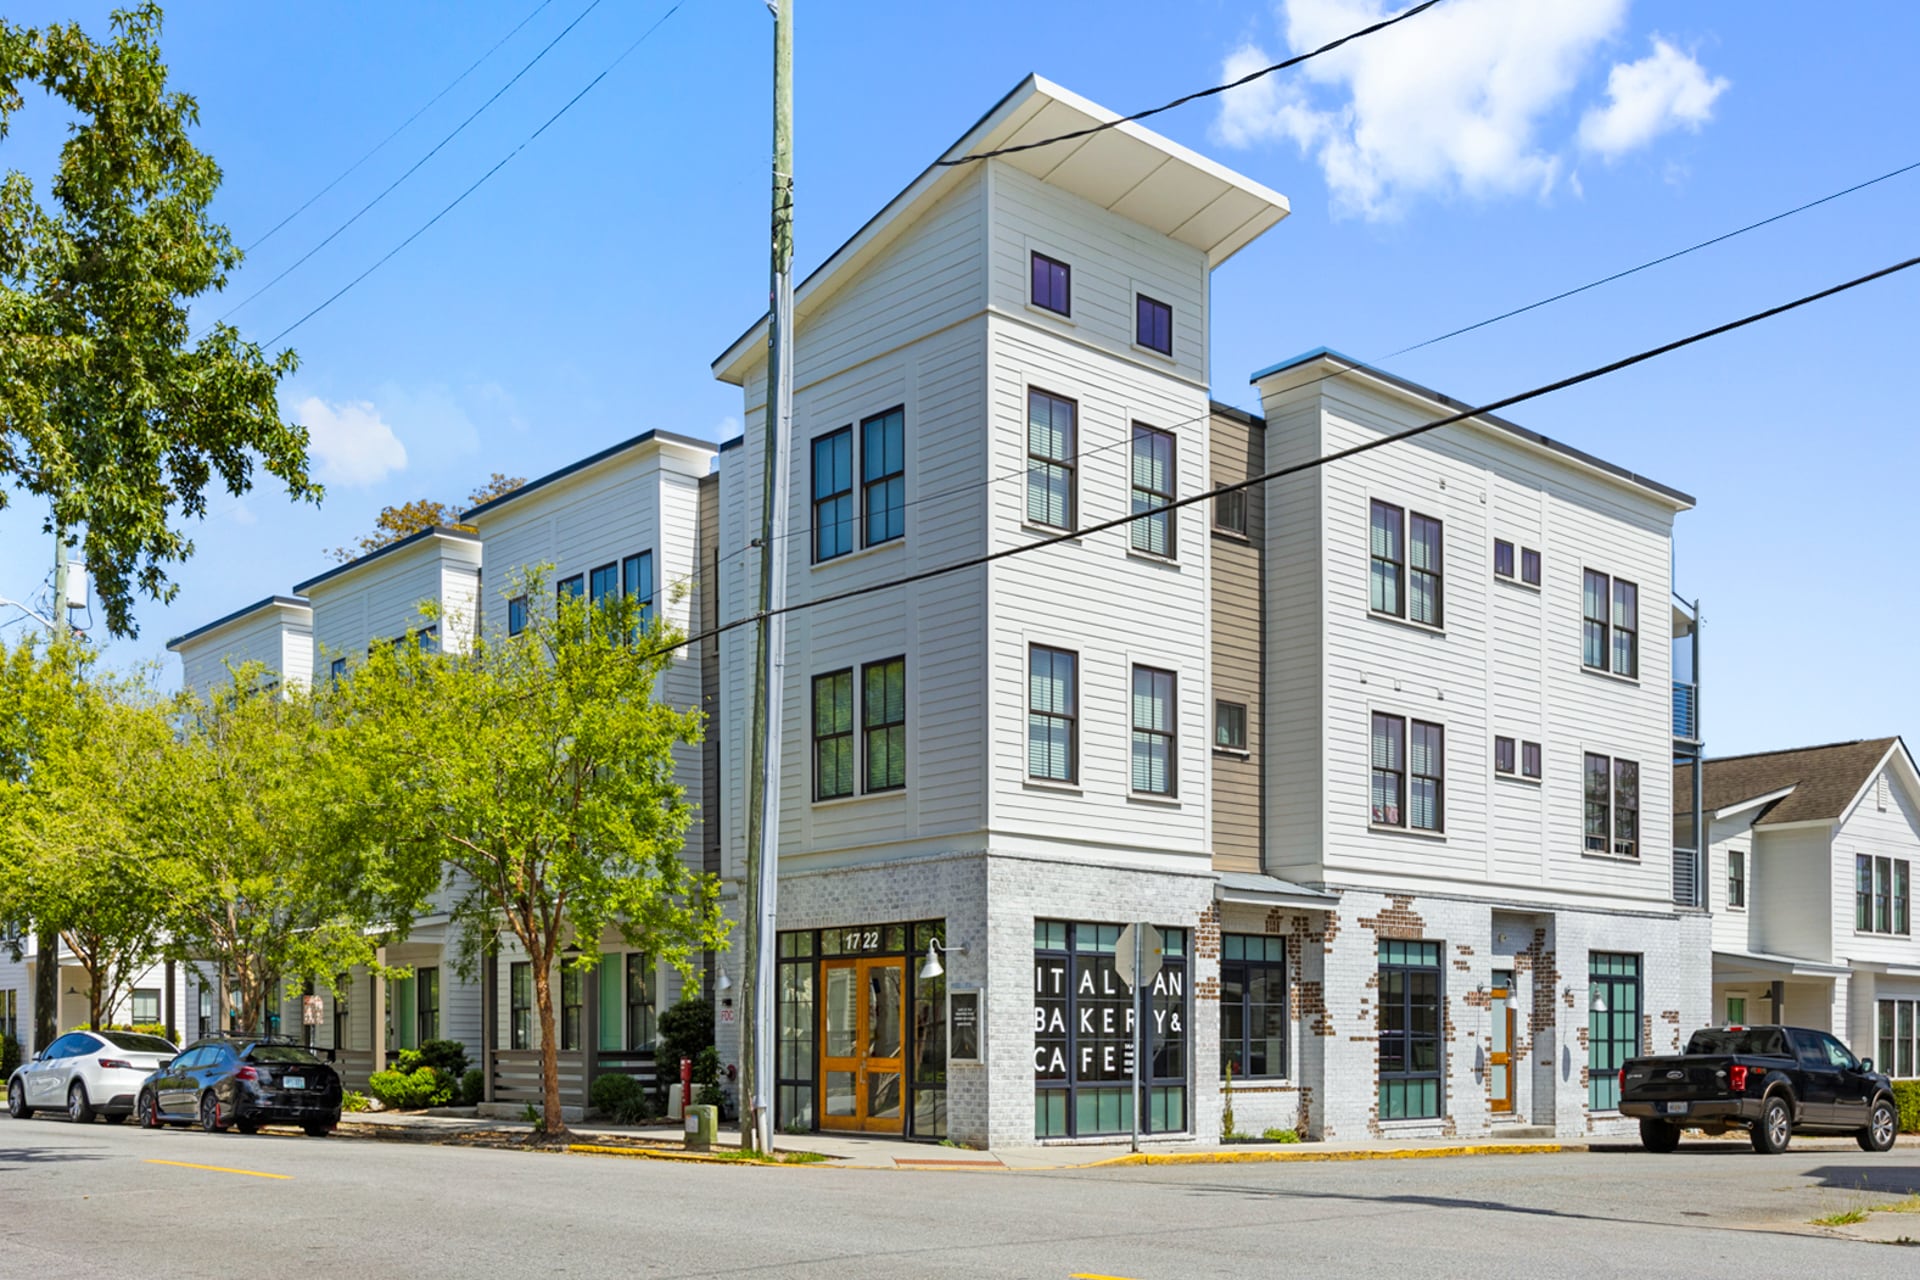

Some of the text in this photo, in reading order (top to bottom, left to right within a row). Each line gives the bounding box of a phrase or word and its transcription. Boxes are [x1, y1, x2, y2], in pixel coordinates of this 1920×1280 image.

[846, 932, 878, 950] 1722
[1037, 966, 1182, 996] ITALAN
[1034, 1046, 1116, 1073] CAFE
